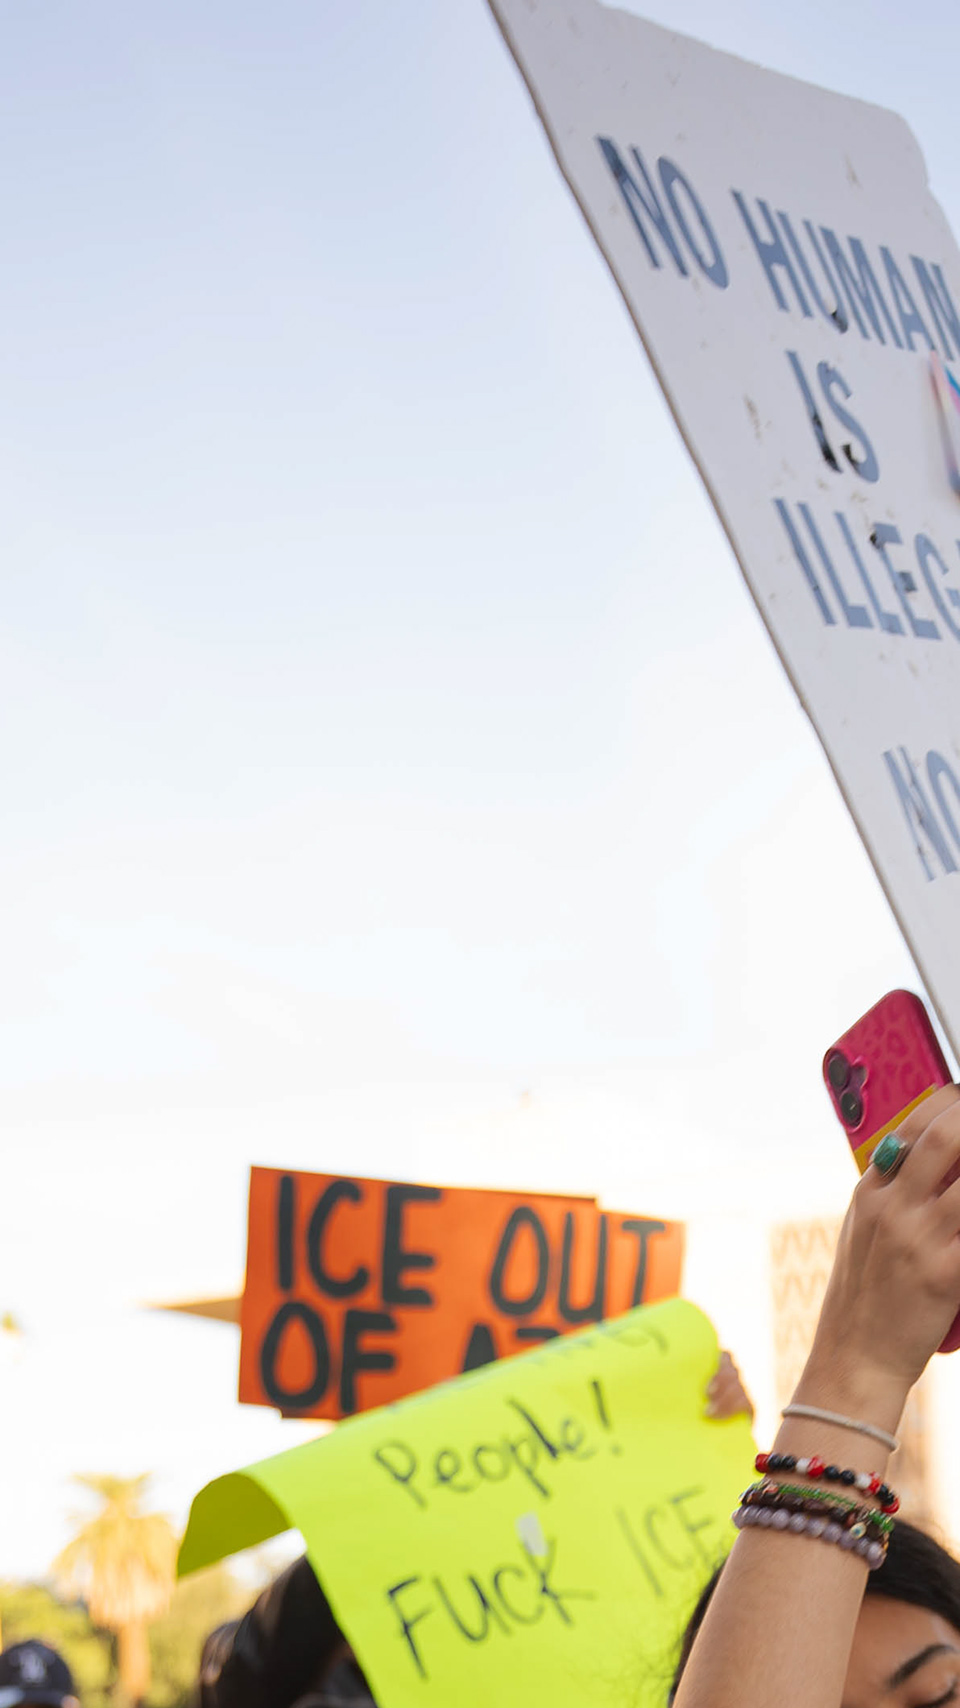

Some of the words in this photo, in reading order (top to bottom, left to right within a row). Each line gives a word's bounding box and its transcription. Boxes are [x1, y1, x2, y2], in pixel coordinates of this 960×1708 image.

[595, 135, 729, 290] NO
[785, 349, 880, 485] IS
[276, 1174, 442, 1308] ICE
[489, 1206, 667, 1321] OUT
[259, 1301, 398, 1413] OF
[373, 1380, 624, 1509] People!
[386, 1537, 597, 1682] FUCK
[612, 1484, 714, 1598] ICE
